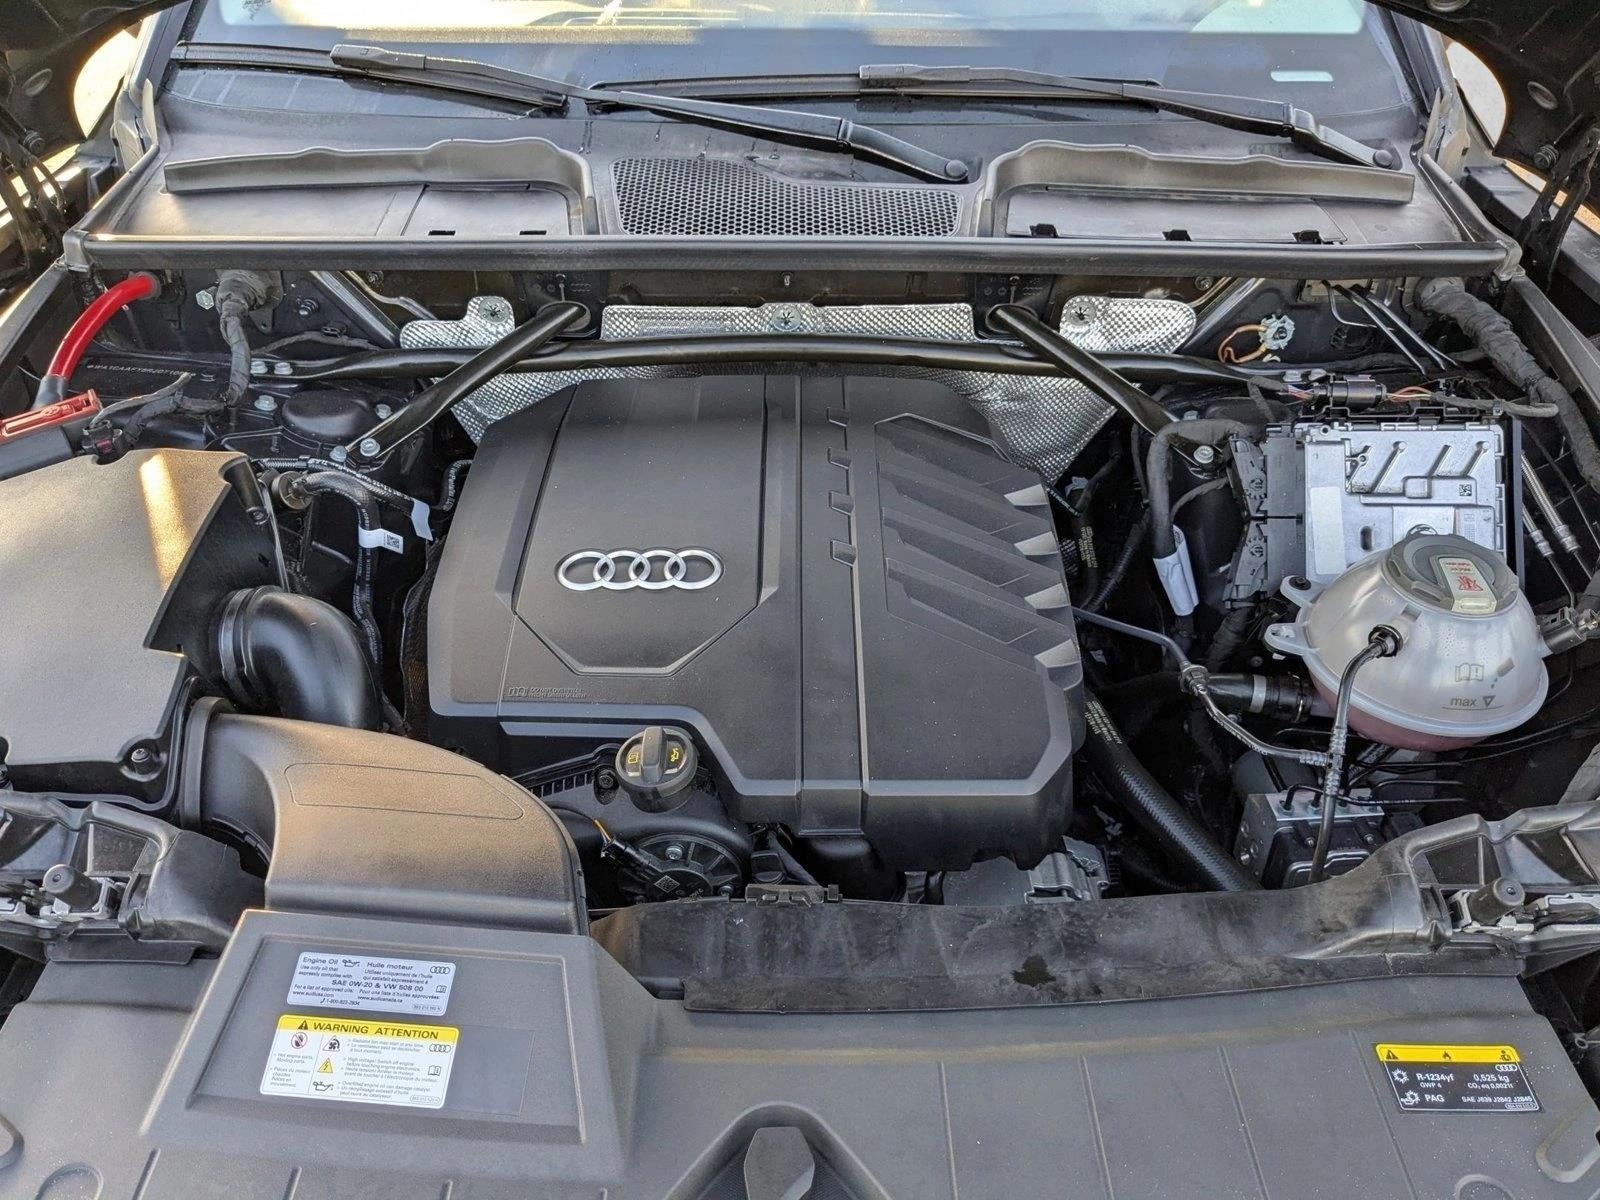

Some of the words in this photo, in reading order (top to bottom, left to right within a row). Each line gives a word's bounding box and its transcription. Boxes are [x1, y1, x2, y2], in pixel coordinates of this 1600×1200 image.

[1450, 697, 1477, 707] max
[312, 1022, 369, 1034] WARNING
[374, 1026, 439, 1039] ATTENTION
[1416, 1073, 1455, 1083] R-1234yf
[1499, 1074, 1510, 1082] kg
[1424, 1094, 1444, 1102] PAG
